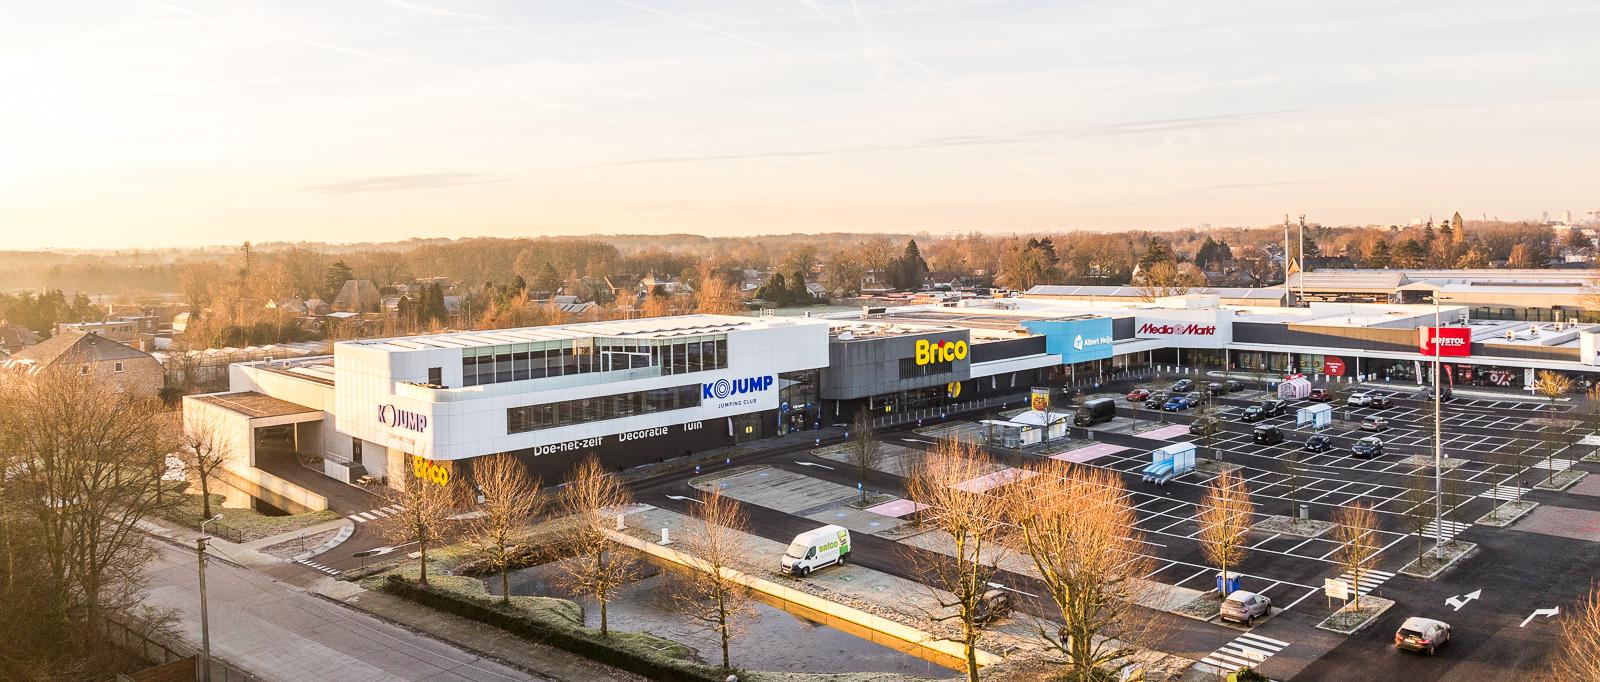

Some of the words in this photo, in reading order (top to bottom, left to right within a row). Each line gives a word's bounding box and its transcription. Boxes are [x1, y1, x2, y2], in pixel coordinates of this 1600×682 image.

[1137, 322, 1174, 335] Media
[1182, 323, 1216, 336] Markt
[1084, 337, 1100, 347] Albert
[915, 338, 968, 366] Brico
[718, 400, 742, 408] JUMPING
[618, 425, 668, 442] Decoratie
